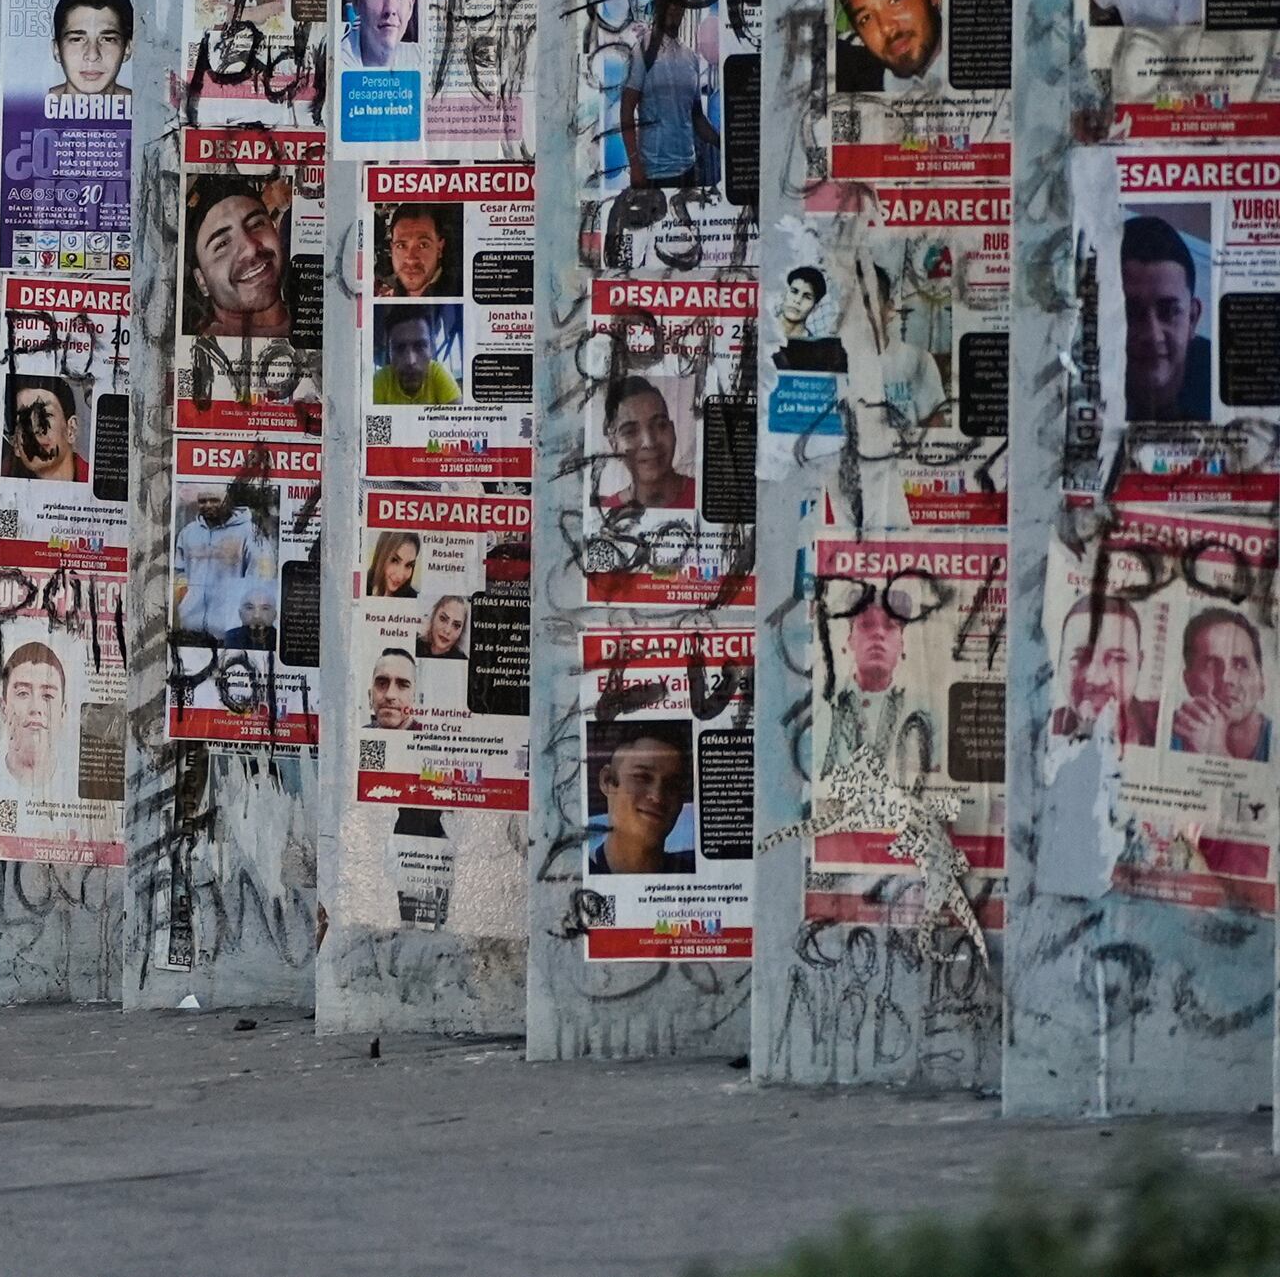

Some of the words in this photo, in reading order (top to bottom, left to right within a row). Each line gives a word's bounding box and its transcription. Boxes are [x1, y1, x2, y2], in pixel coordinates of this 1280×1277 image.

[362, 76, 400, 87] Persona
[349, 88, 413, 101] desaparecida
[349, 105, 366, 116] ¿La
[367, 105, 383, 115] has
[384, 103, 413, 116] visto?
[108, 140, 118, 148] ÉL
[60, 159, 77, 167] MÁS
[53, 169, 122, 177] DESAPARECIDOS
[8, 188, 78, 201] AGOSTO
[79, 184, 103, 206] 30
[480, 203, 507, 213] Cesar
[489, 310, 528, 322] Jonatha
[515, 332, 531, 340] años
[428, 429, 488, 439] Guadalajara
[423, 535, 444, 544] Erika
[432, 549, 464, 559] Rosales
[428, 562, 465, 572] Martínez
[365, 613, 386, 623] Rosa
[388, 614, 422, 624] Adriana
[380, 628, 409, 638] Ruelas
[441, 723, 462, 733] Cruz
